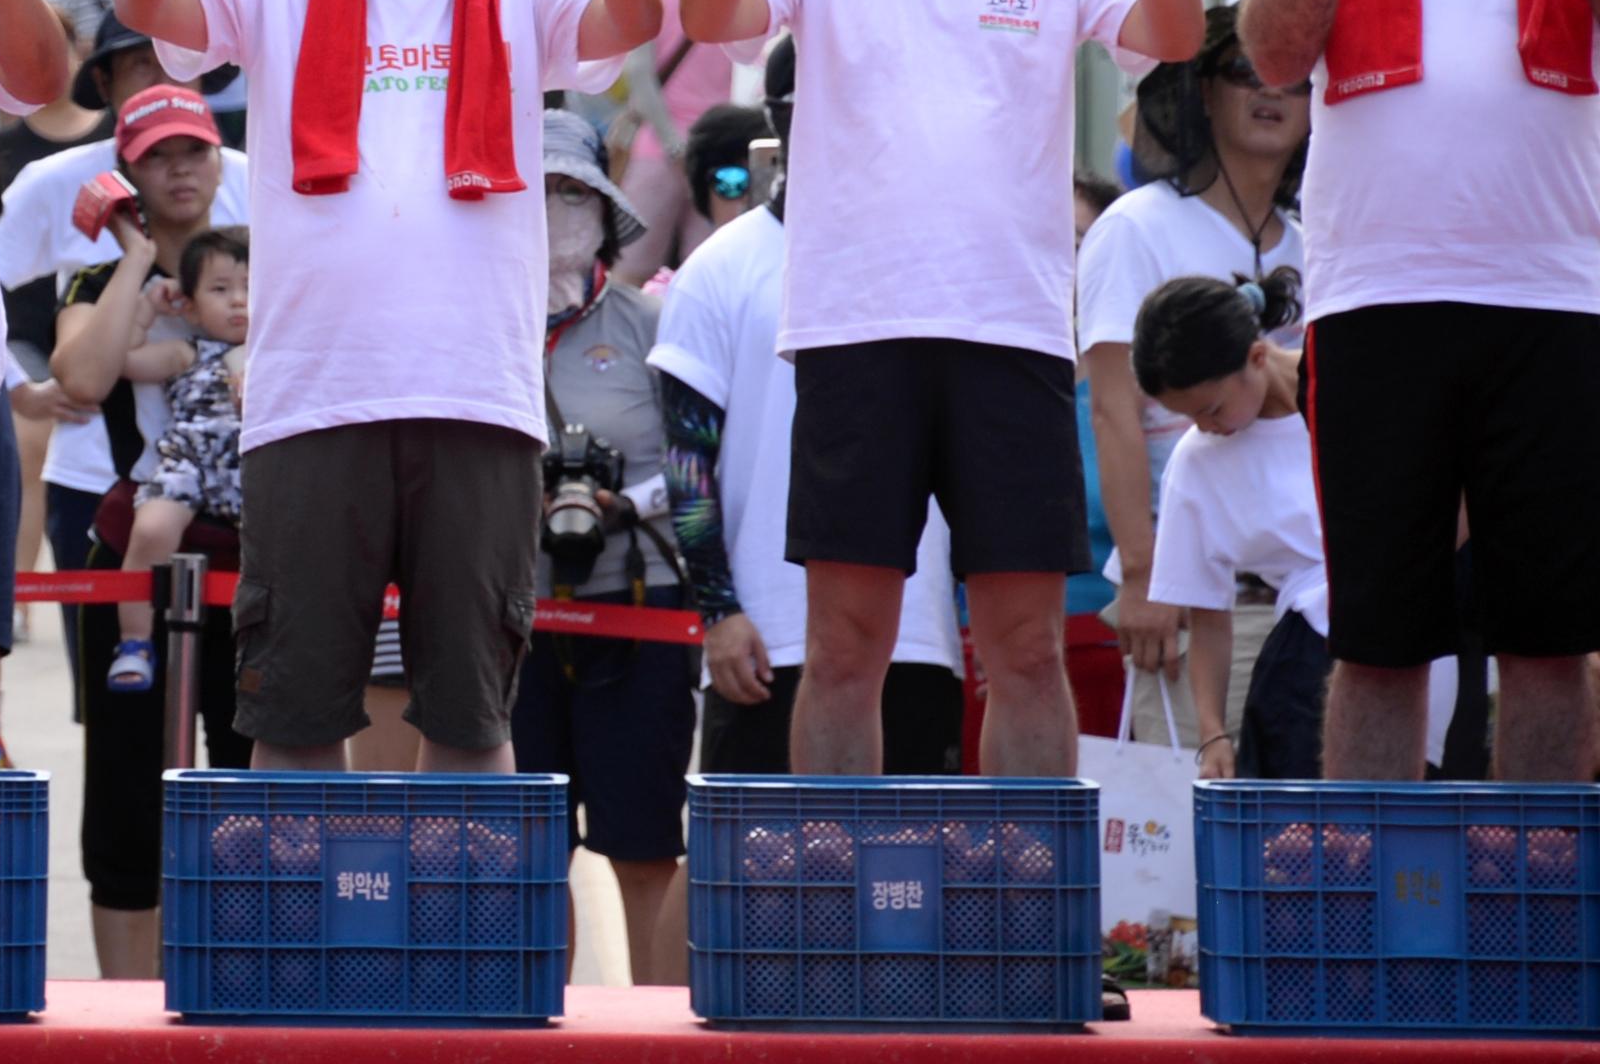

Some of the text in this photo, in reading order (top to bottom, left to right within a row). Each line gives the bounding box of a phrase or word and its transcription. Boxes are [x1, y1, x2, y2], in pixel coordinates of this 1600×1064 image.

[364, 43, 452, 75] 토마토
[365, 75, 449, 93] ATO FES
[1532, 70, 1568, 88] noma
[171, 96, 206, 115] Staff
[336, 871, 391, 901] 화악산
